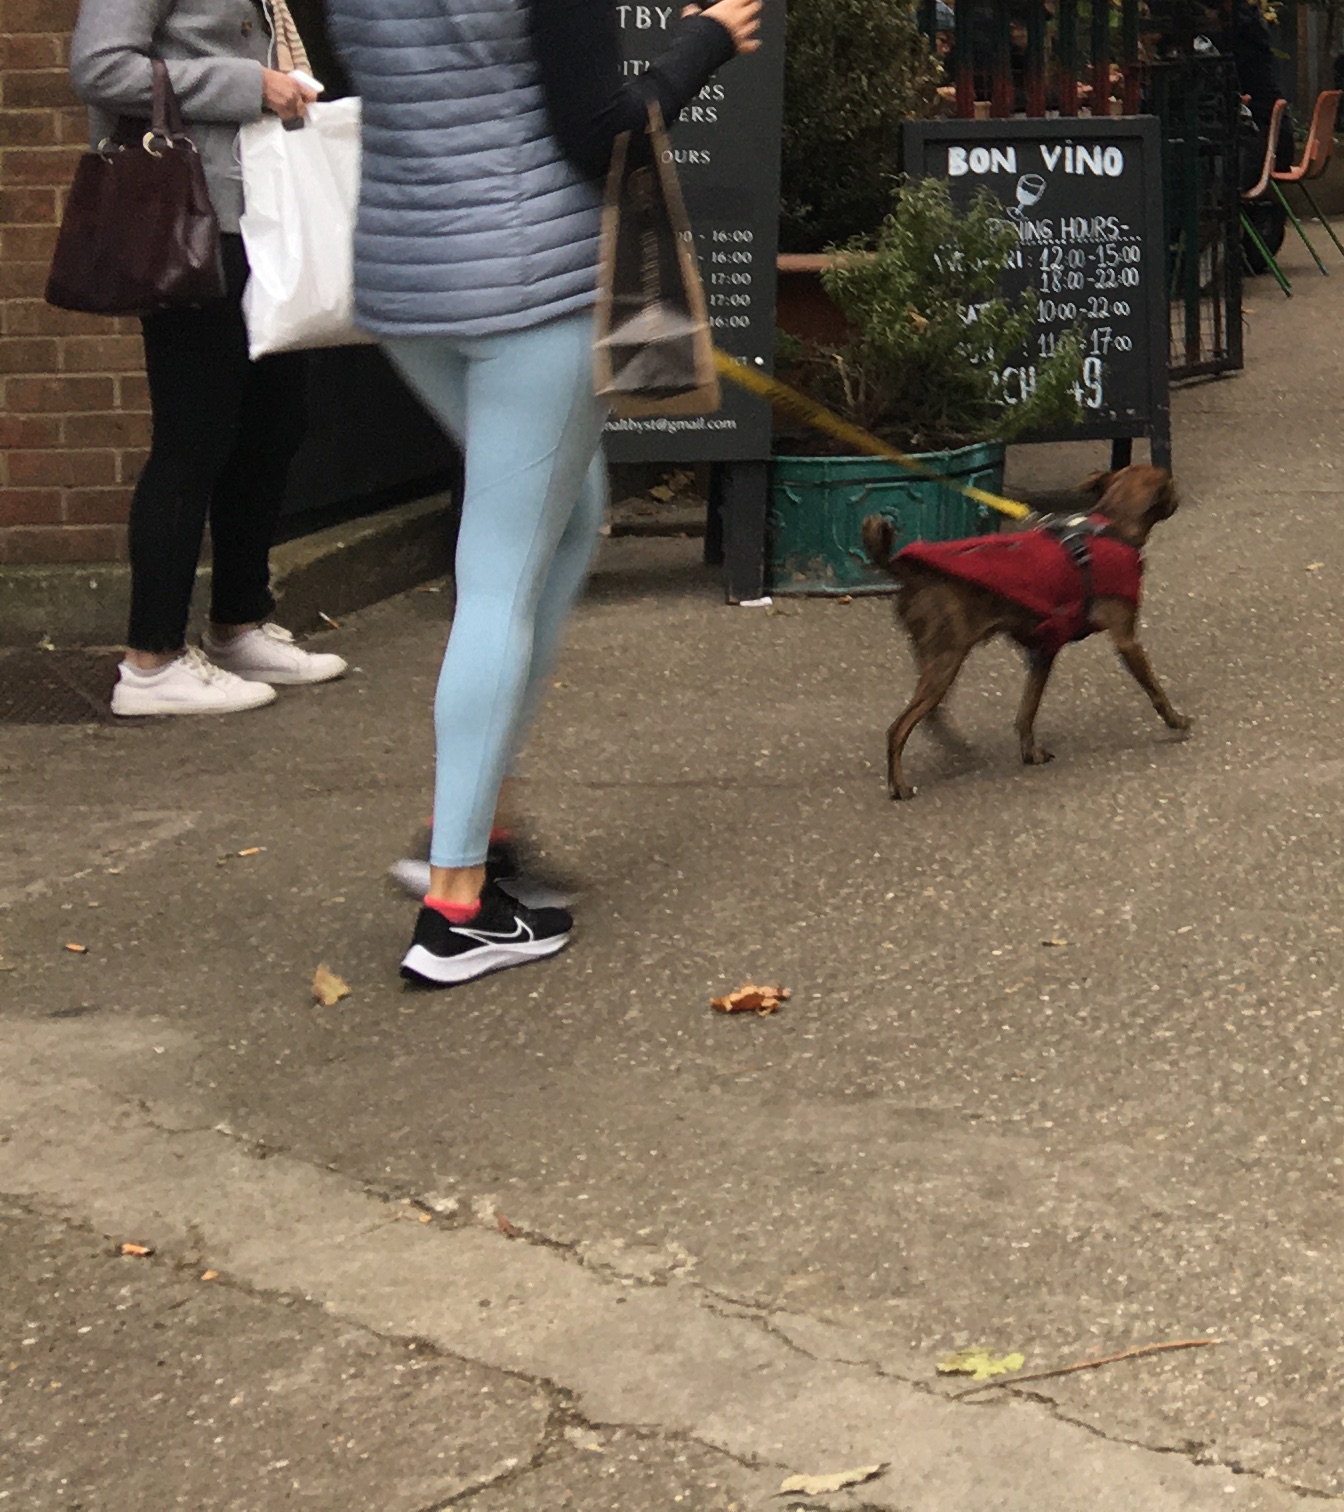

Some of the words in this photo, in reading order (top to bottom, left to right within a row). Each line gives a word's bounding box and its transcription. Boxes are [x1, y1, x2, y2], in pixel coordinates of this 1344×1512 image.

[947, 146, 1017, 176] BON
[712, 229, 754, 243] 16:00
[711, 250, 753, 264] 16:00
[711, 272, 752, 286] 17:00
[710, 294, 751, 307] 17:00
